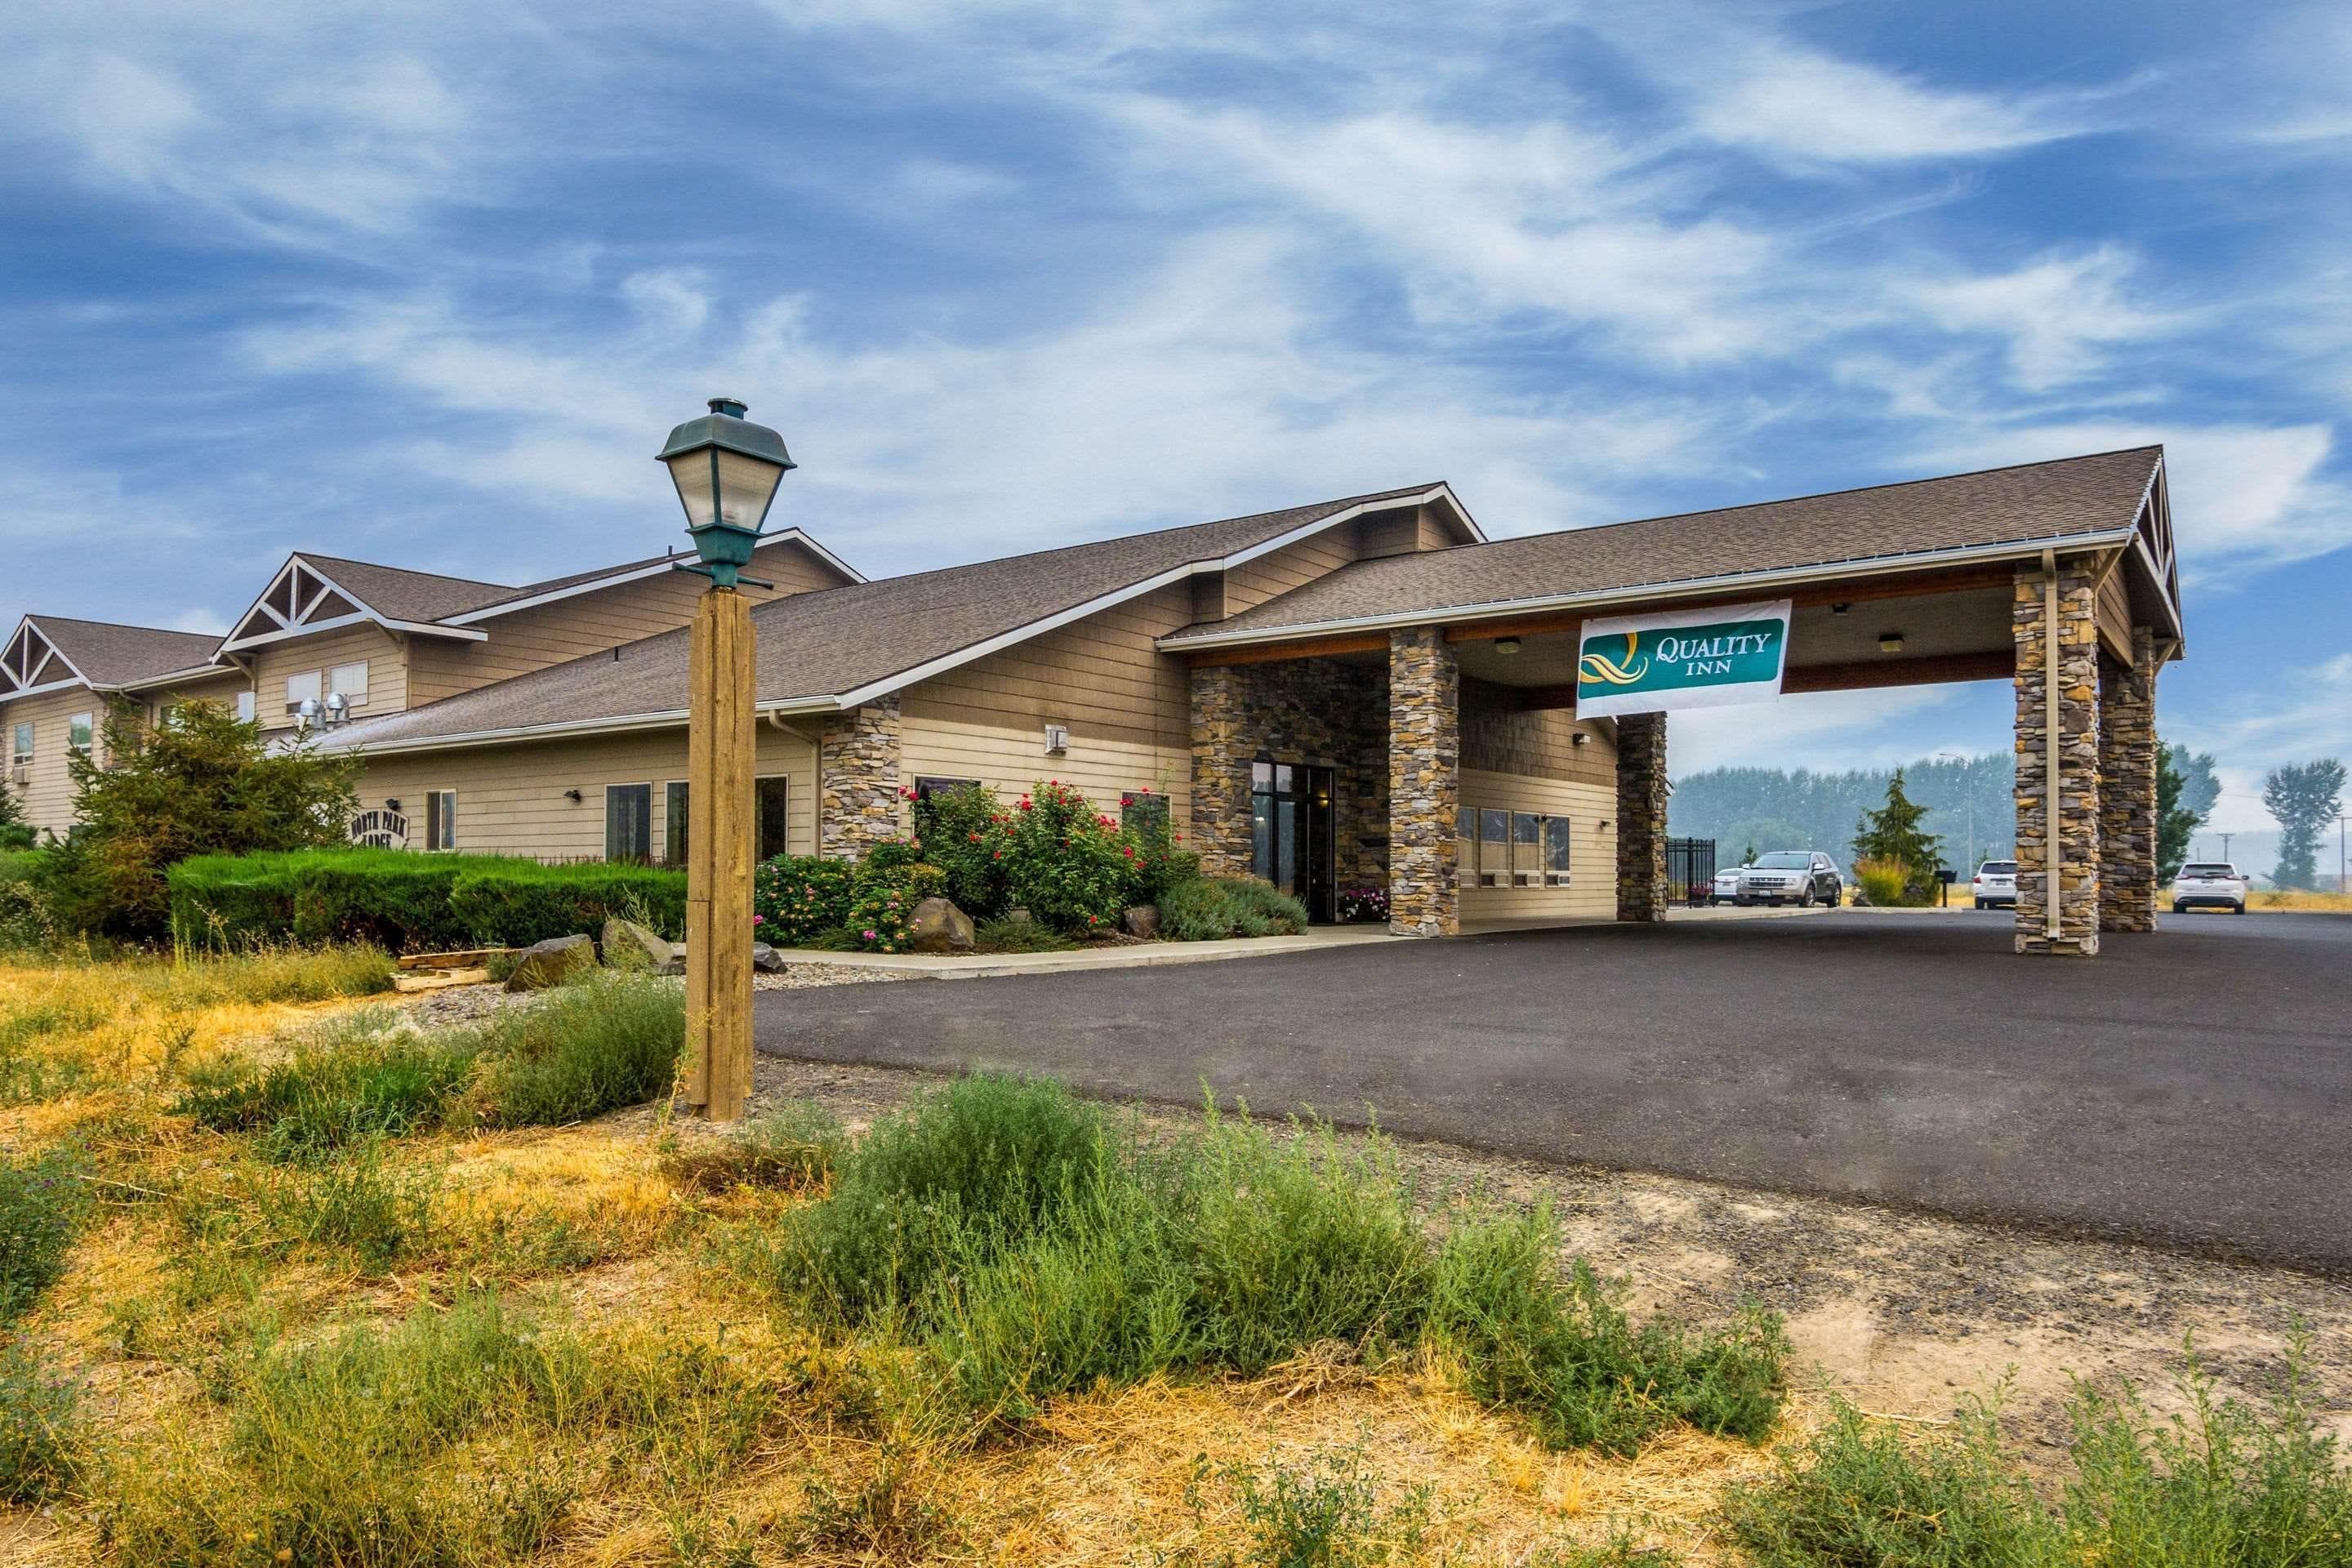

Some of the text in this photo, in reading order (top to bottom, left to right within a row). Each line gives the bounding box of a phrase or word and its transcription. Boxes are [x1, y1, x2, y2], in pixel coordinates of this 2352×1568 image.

[1656, 633, 1772, 663] QUALITY
[1685, 659, 1733, 676] INN
[351, 810, 407, 840] NORTH PARK
